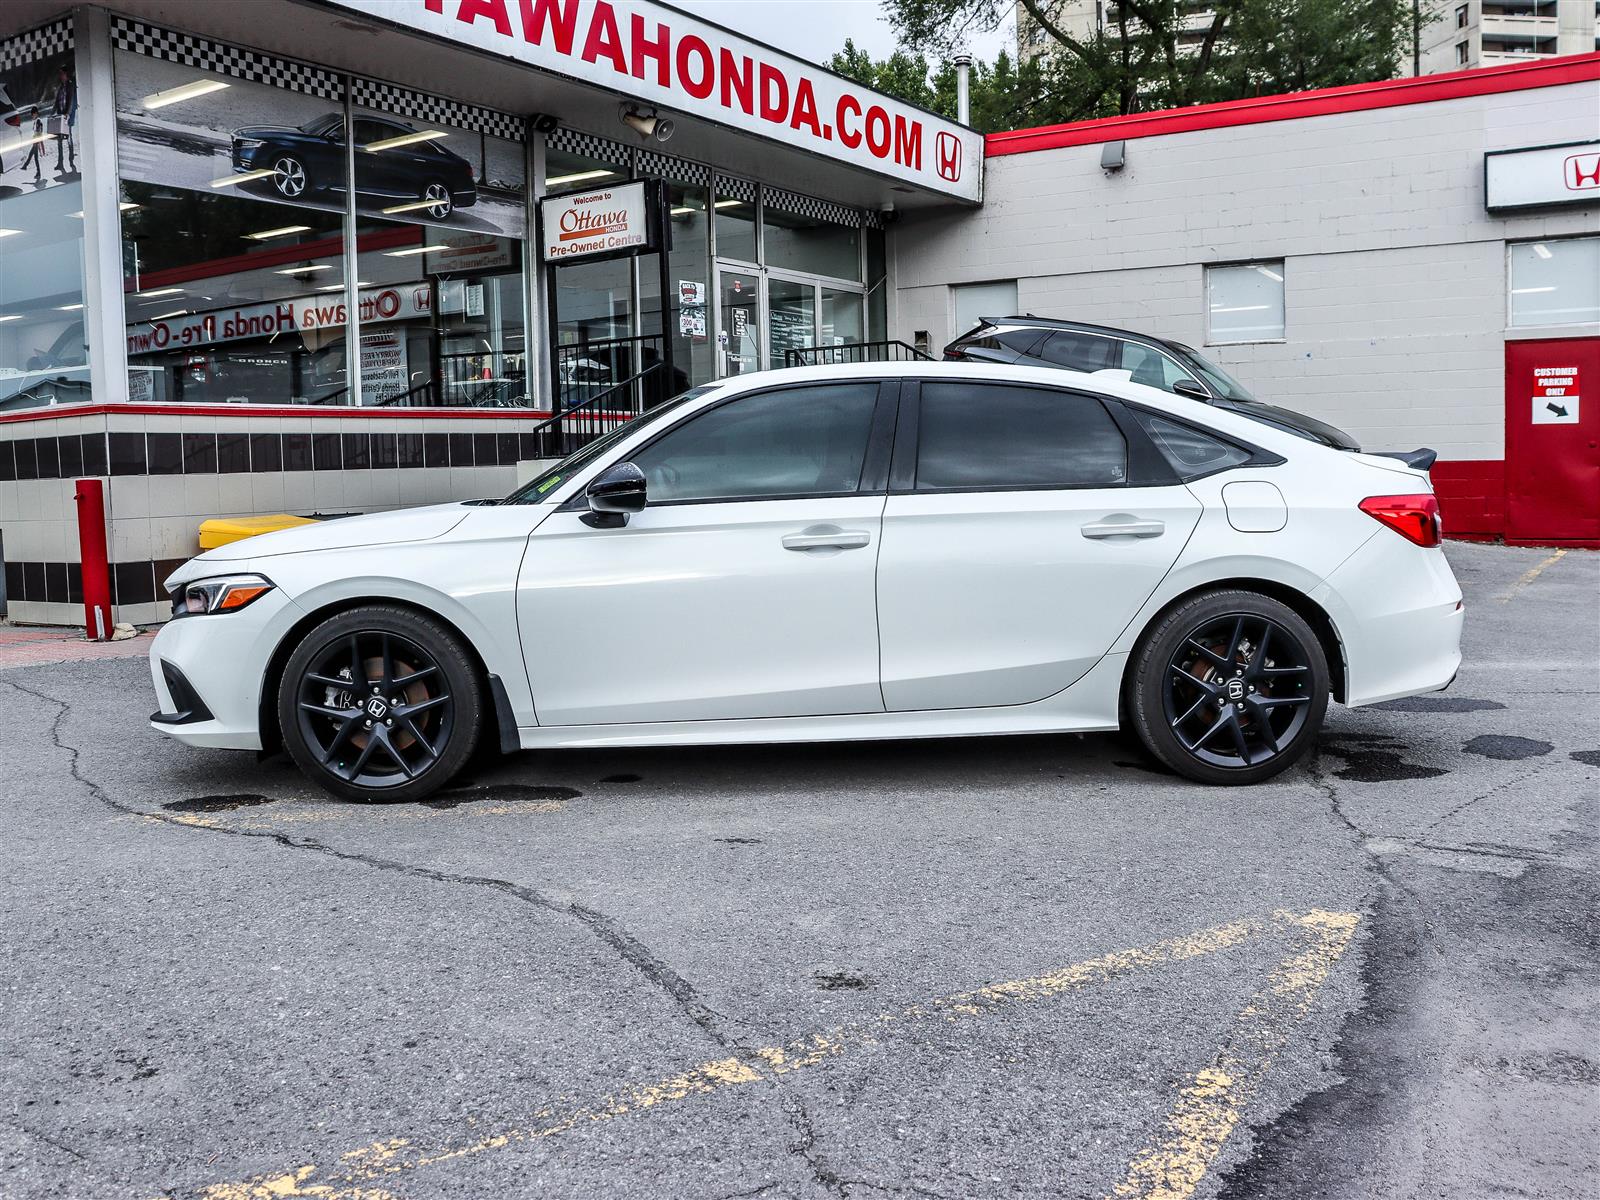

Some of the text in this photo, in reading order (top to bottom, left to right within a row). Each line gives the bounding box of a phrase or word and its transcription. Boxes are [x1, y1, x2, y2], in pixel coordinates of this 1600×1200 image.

[425, 0, 922, 170] WAHONDA.COM
[573, 192, 612, 206] Welcome to
[559, 207, 628, 233] Ottawa
[605, 224, 627, 233] HONDA
[550, 233, 642, 257] Pre-Owned Centre
[1534, 367, 1578, 377] CUSTOMER
[1538, 377, 1573, 387] PARKING
[1545, 387, 1566, 396] ONLY
